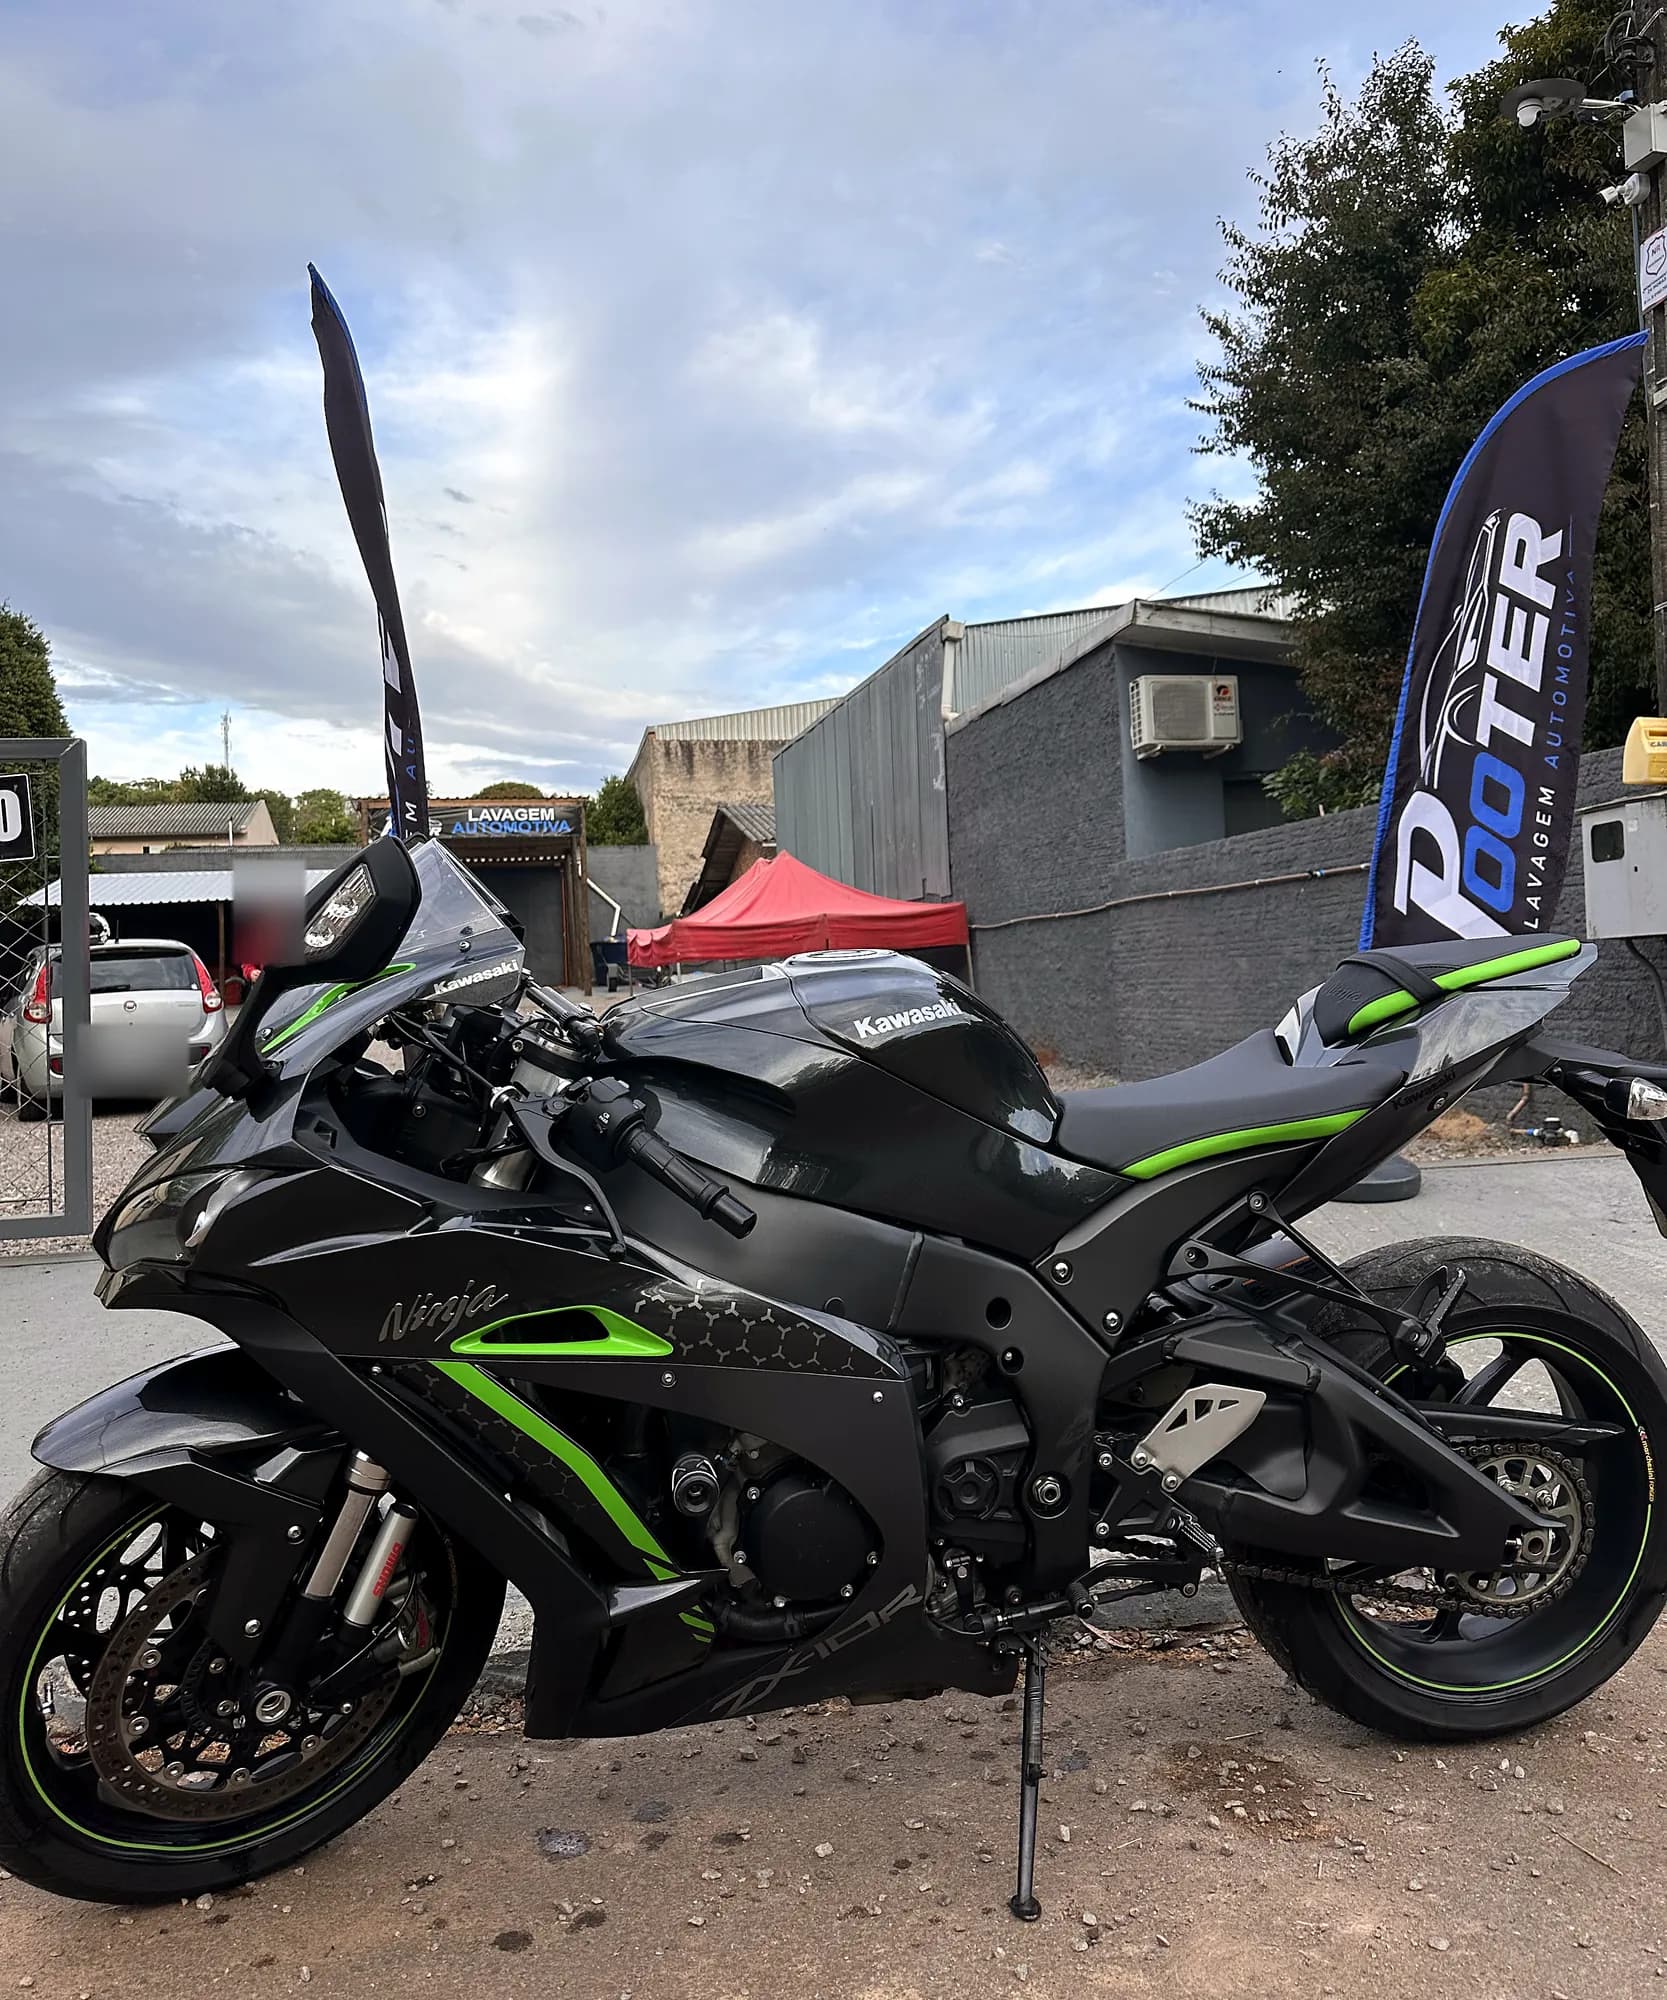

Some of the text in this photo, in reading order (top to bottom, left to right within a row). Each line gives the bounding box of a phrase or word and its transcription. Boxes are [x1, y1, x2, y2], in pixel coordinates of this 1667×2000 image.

[1394, 512, 1564, 940] POOTER
[452, 820, 572, 834] AUTOMOTIVA
[468, 808, 555, 821] LAVAGEM
[1523, 786, 1556, 929] LAVAGEM
[433, 960, 519, 995] Kawasaki
[853, 998, 962, 1039] Kawasaki
[378, 1280, 509, 1342] Ninja
